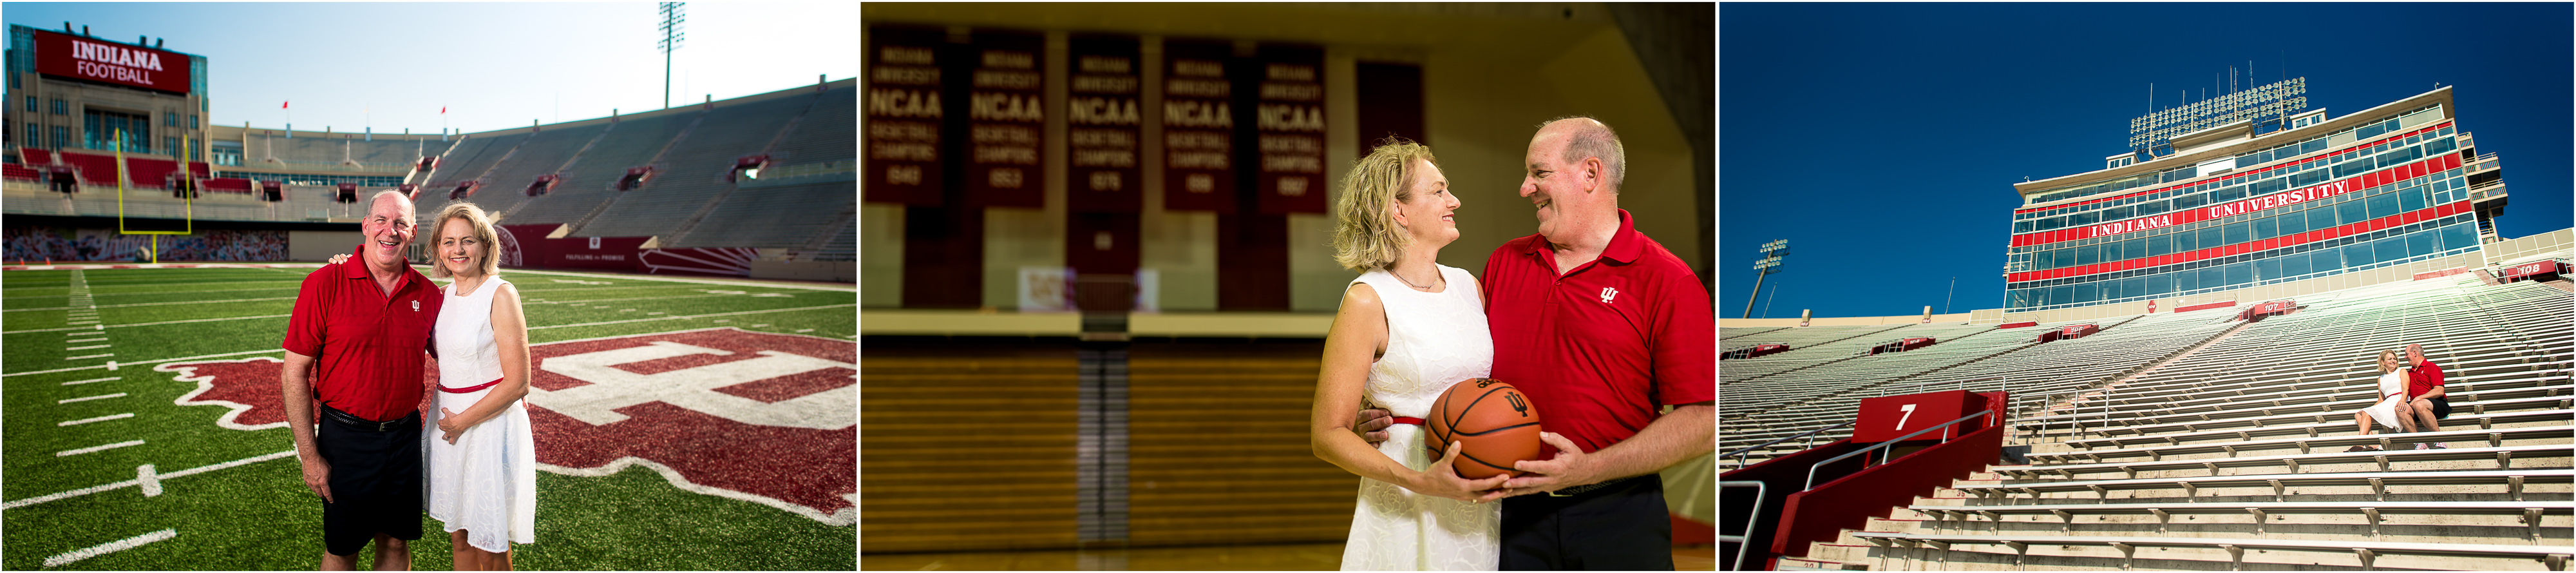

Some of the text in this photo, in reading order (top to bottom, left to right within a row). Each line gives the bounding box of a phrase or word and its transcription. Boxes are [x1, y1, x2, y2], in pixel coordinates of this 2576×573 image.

[72, 40, 163, 71] INDIANA
[77, 60, 153, 84] FOOTBALL
[870, 89, 942, 117] NCAA
[971, 93, 1043, 122] NCAA
[1069, 97, 1140, 124] NCAA
[1164, 101, 1232, 129] NCAA
[1258, 104, 1325, 133] NCAA
[2091, 180, 2345, 238] INDIANA UNIVERSITY
[2519, 264, 2540, 275] 108
[2264, 303, 2279, 311] 107
[1895, 403, 1917, 431] 7
